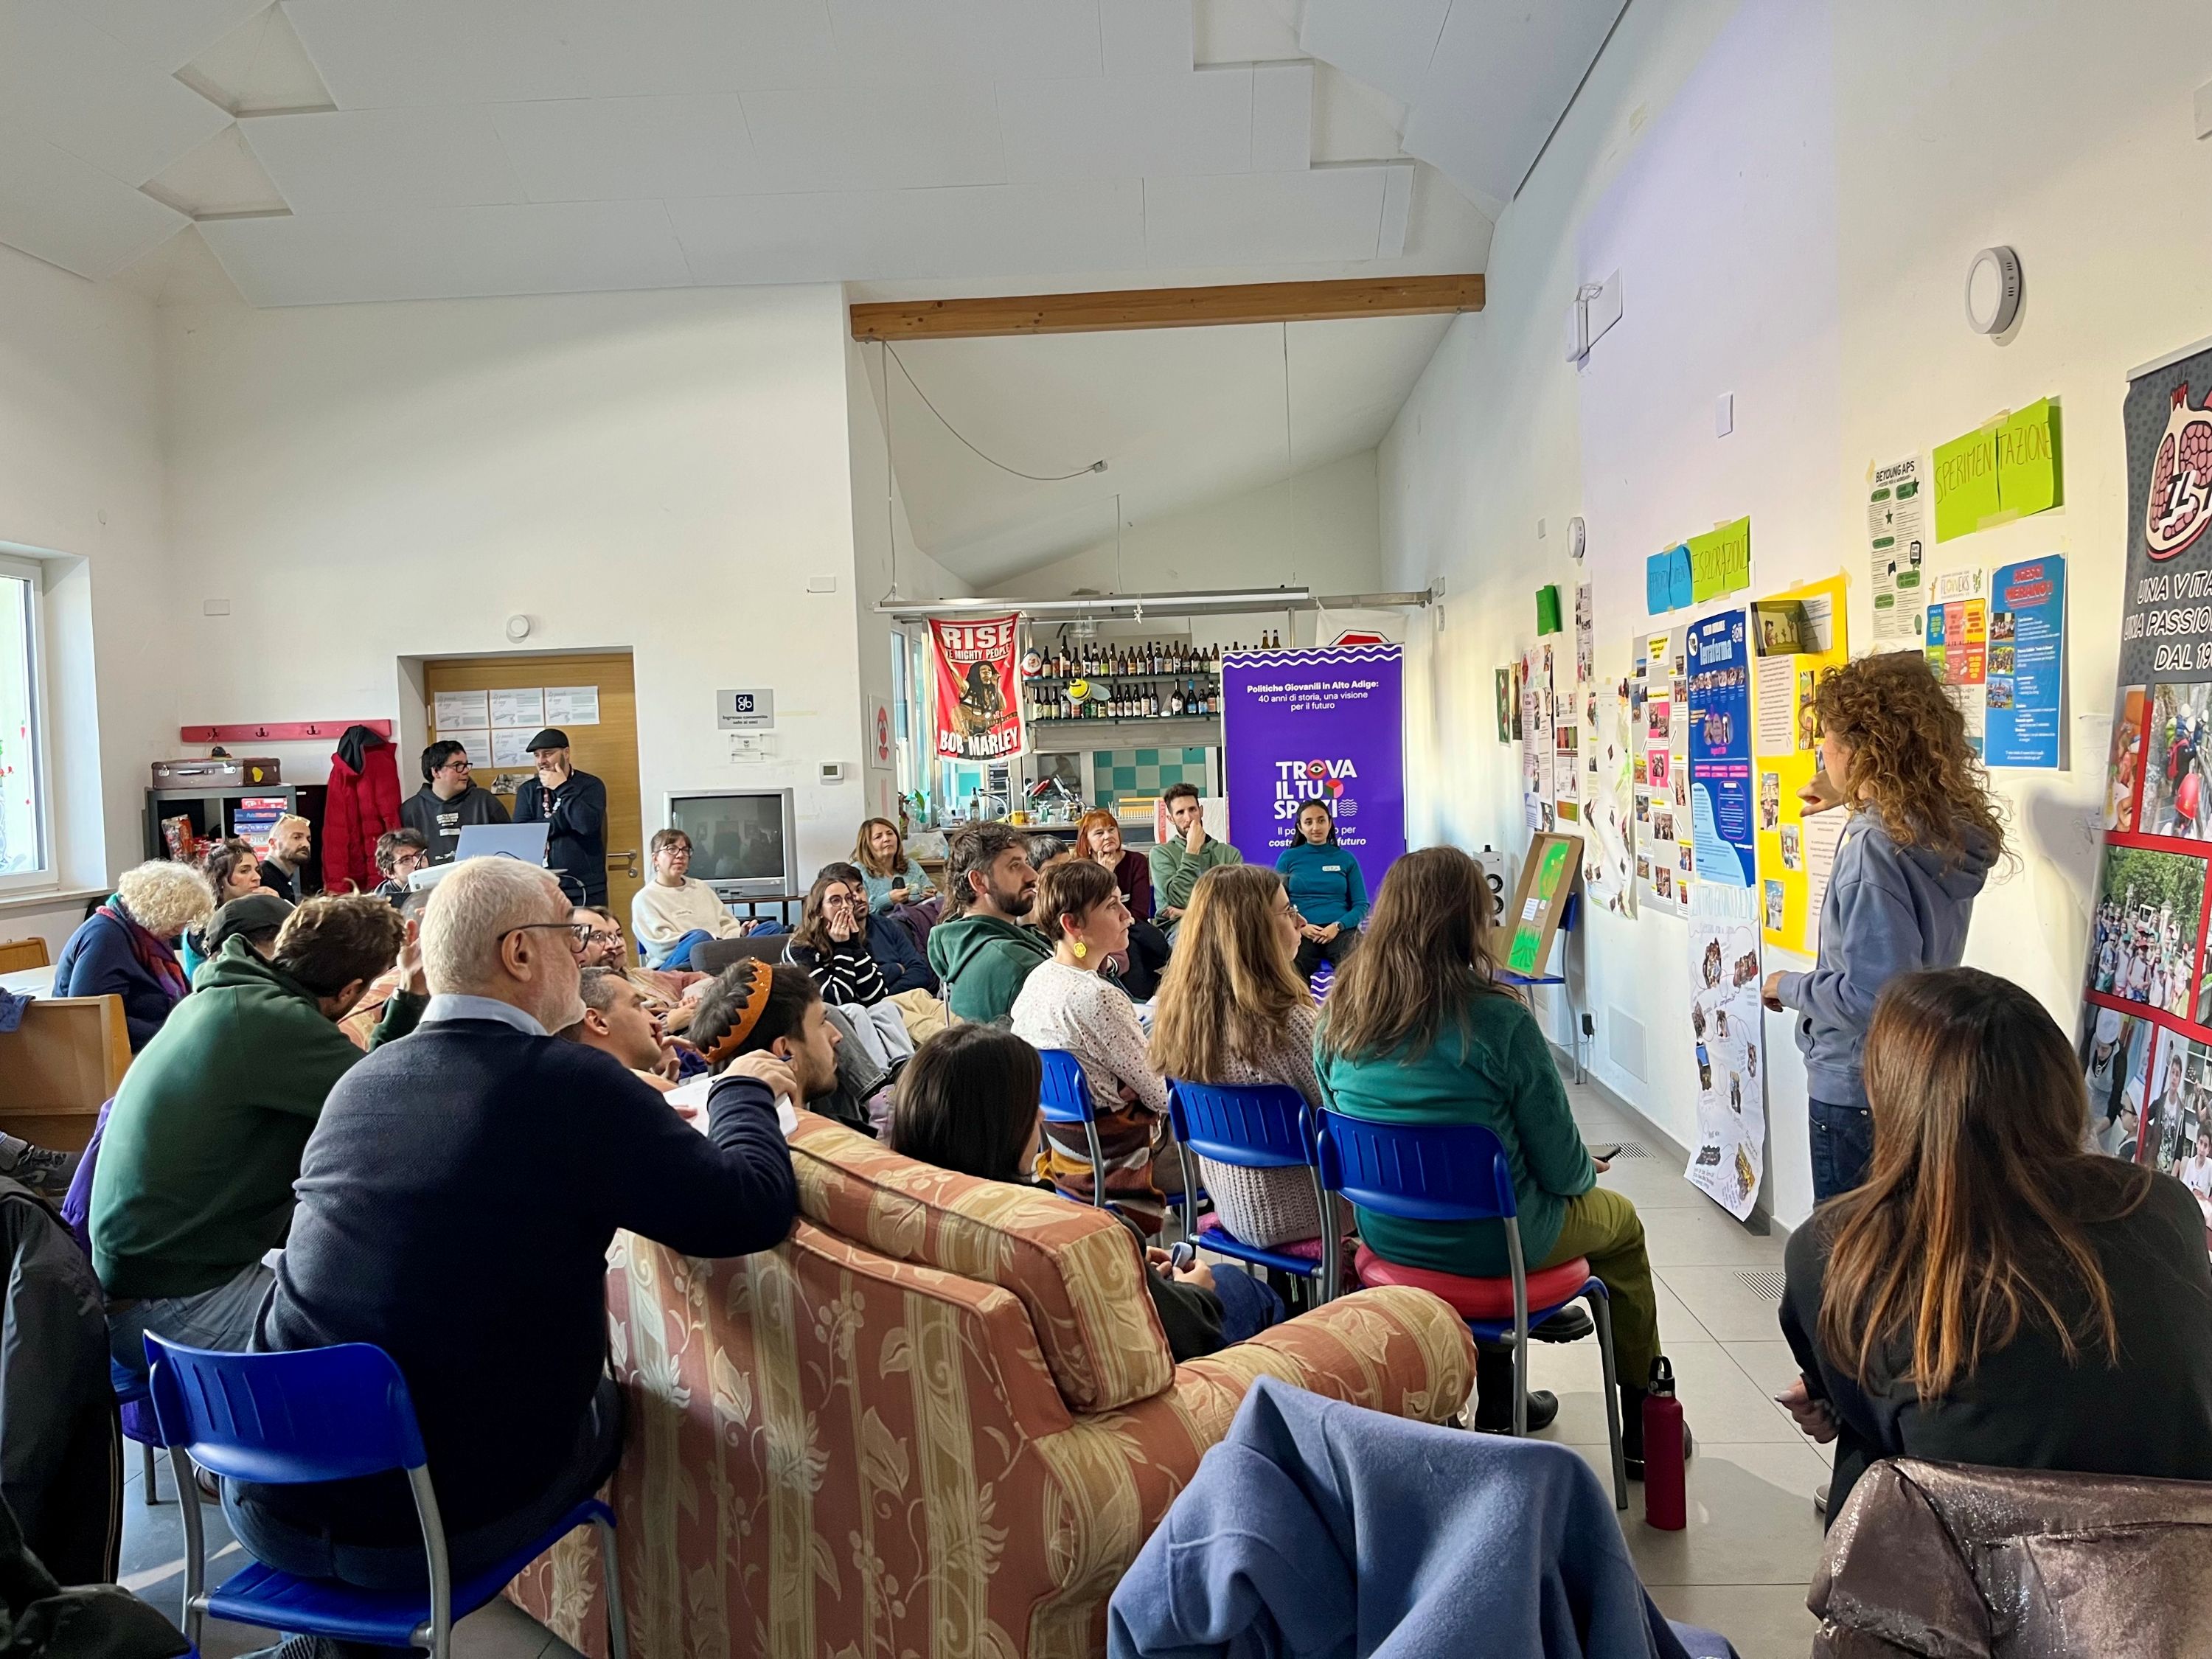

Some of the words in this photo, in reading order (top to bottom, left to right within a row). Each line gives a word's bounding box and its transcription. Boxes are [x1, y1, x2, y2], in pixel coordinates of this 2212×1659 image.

[1876, 465, 1902, 483] BEYOUNG
[1902, 460, 1915, 476] APS
[1935, 420, 2053, 504] SPERIMENTAZIONE
[1692, 534, 1747, 583] ESPLORAZIONE
[2138, 575, 2168, 604] UNA
[2146, 606, 2212, 636] PASSIO
[941, 623, 1013, 650] RISE
[955, 650, 983, 661] MIGHTY
[986, 644, 1010, 659] PEOPLE
[1700, 638, 1733, 666] Terraferma
[2154, 644, 2193, 671] DAL
[2197, 641, 2212, 669] 19
[1247, 684, 1283, 693] Politiche
[1284, 682, 1321, 692] Giovanili
[1322, 681, 1330, 690] in
[1332, 681, 1349, 689] Alto
[1351, 680, 1379, 690] Adige:
[1258, 695, 1270, 703] 40
[1289, 694, 1296, 702] di
[1298, 693, 1322, 701] storia,
[1291, 703, 1304, 712] per
[940, 729, 964, 754] BOB
[969, 726, 1019, 757] MARLEY
[1276, 781, 1294, 800] IL
[1278, 827, 1282, 835] Il
[1341, 827, 1356, 836] per
[1336, 838, 1366, 847] futuro
